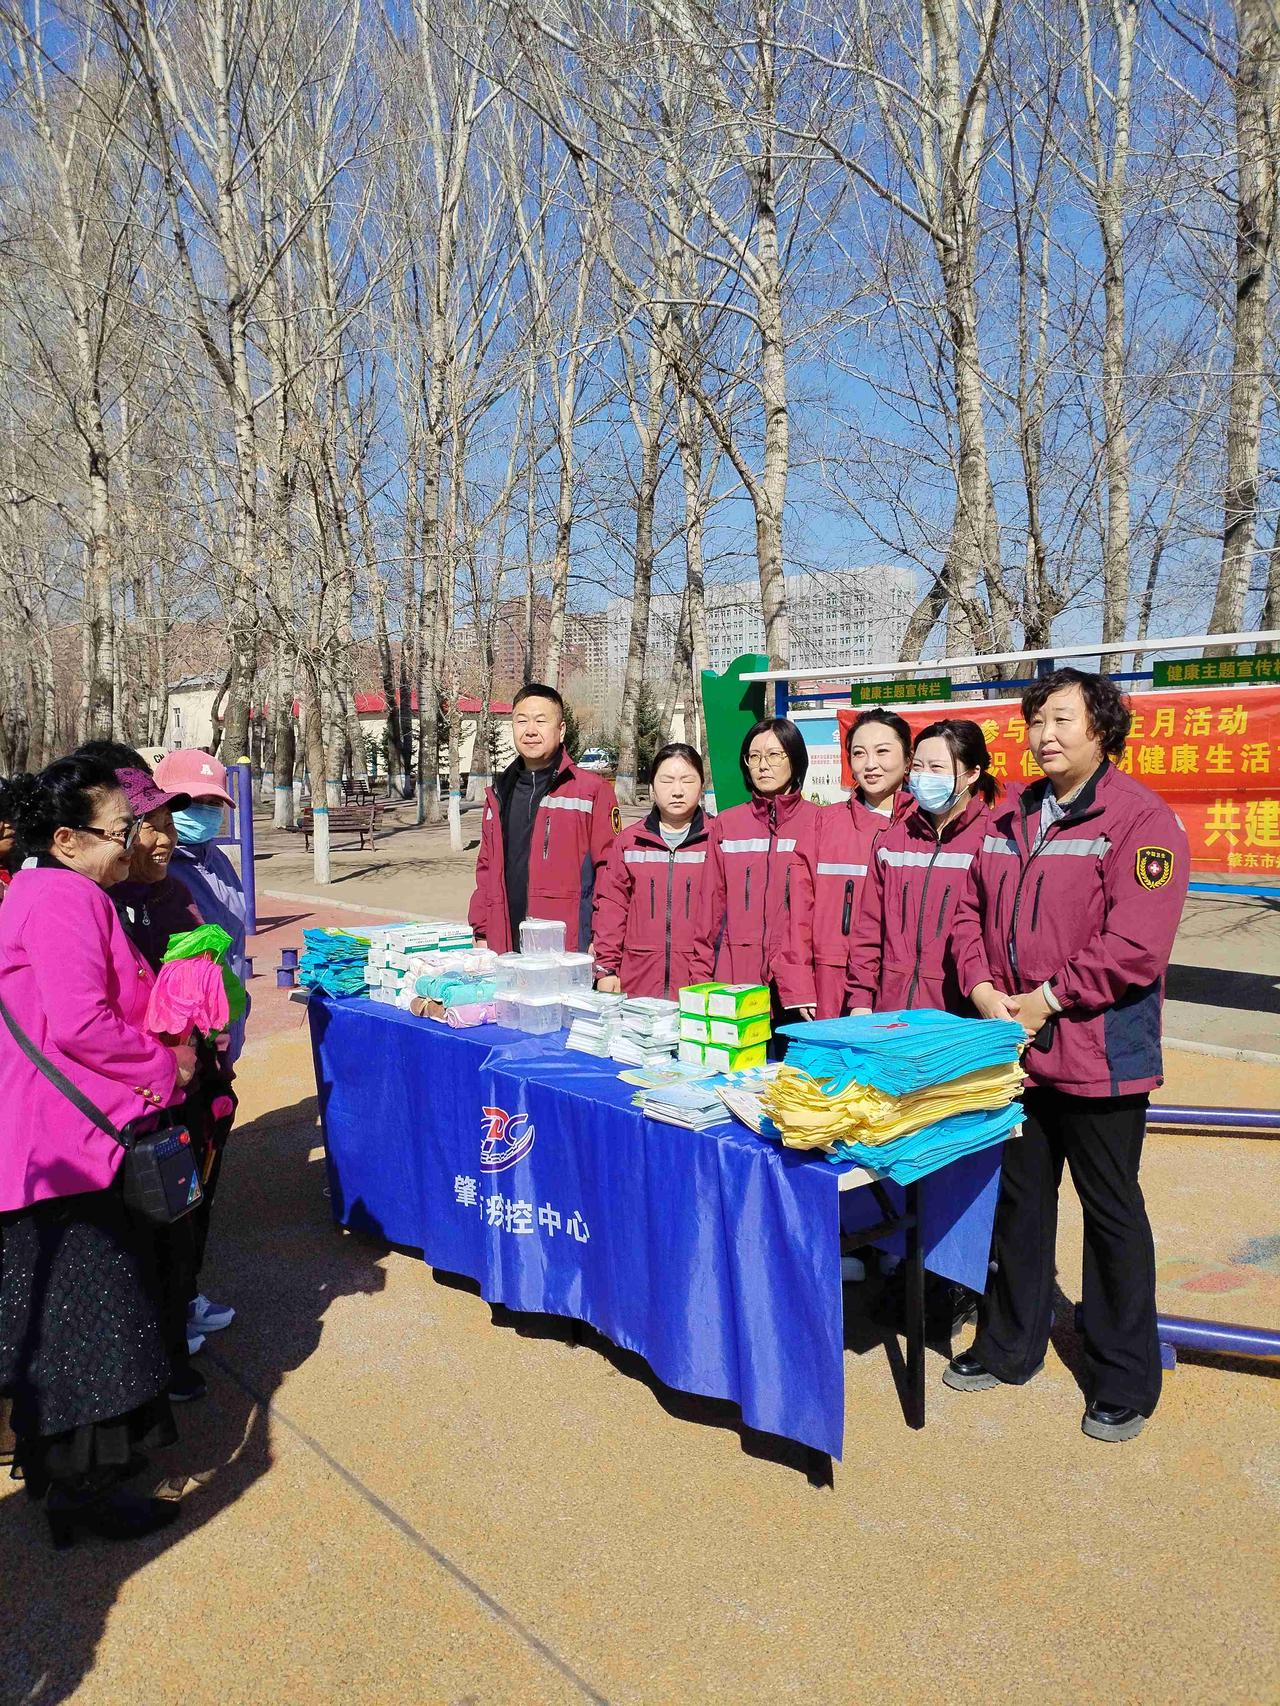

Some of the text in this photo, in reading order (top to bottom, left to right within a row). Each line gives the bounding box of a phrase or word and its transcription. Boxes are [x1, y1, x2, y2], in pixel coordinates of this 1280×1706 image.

[860, 682, 941, 700] 健康主题宣传栏
[200, 764, 213, 776] A
[1203, 797, 1280, 848] 共建
